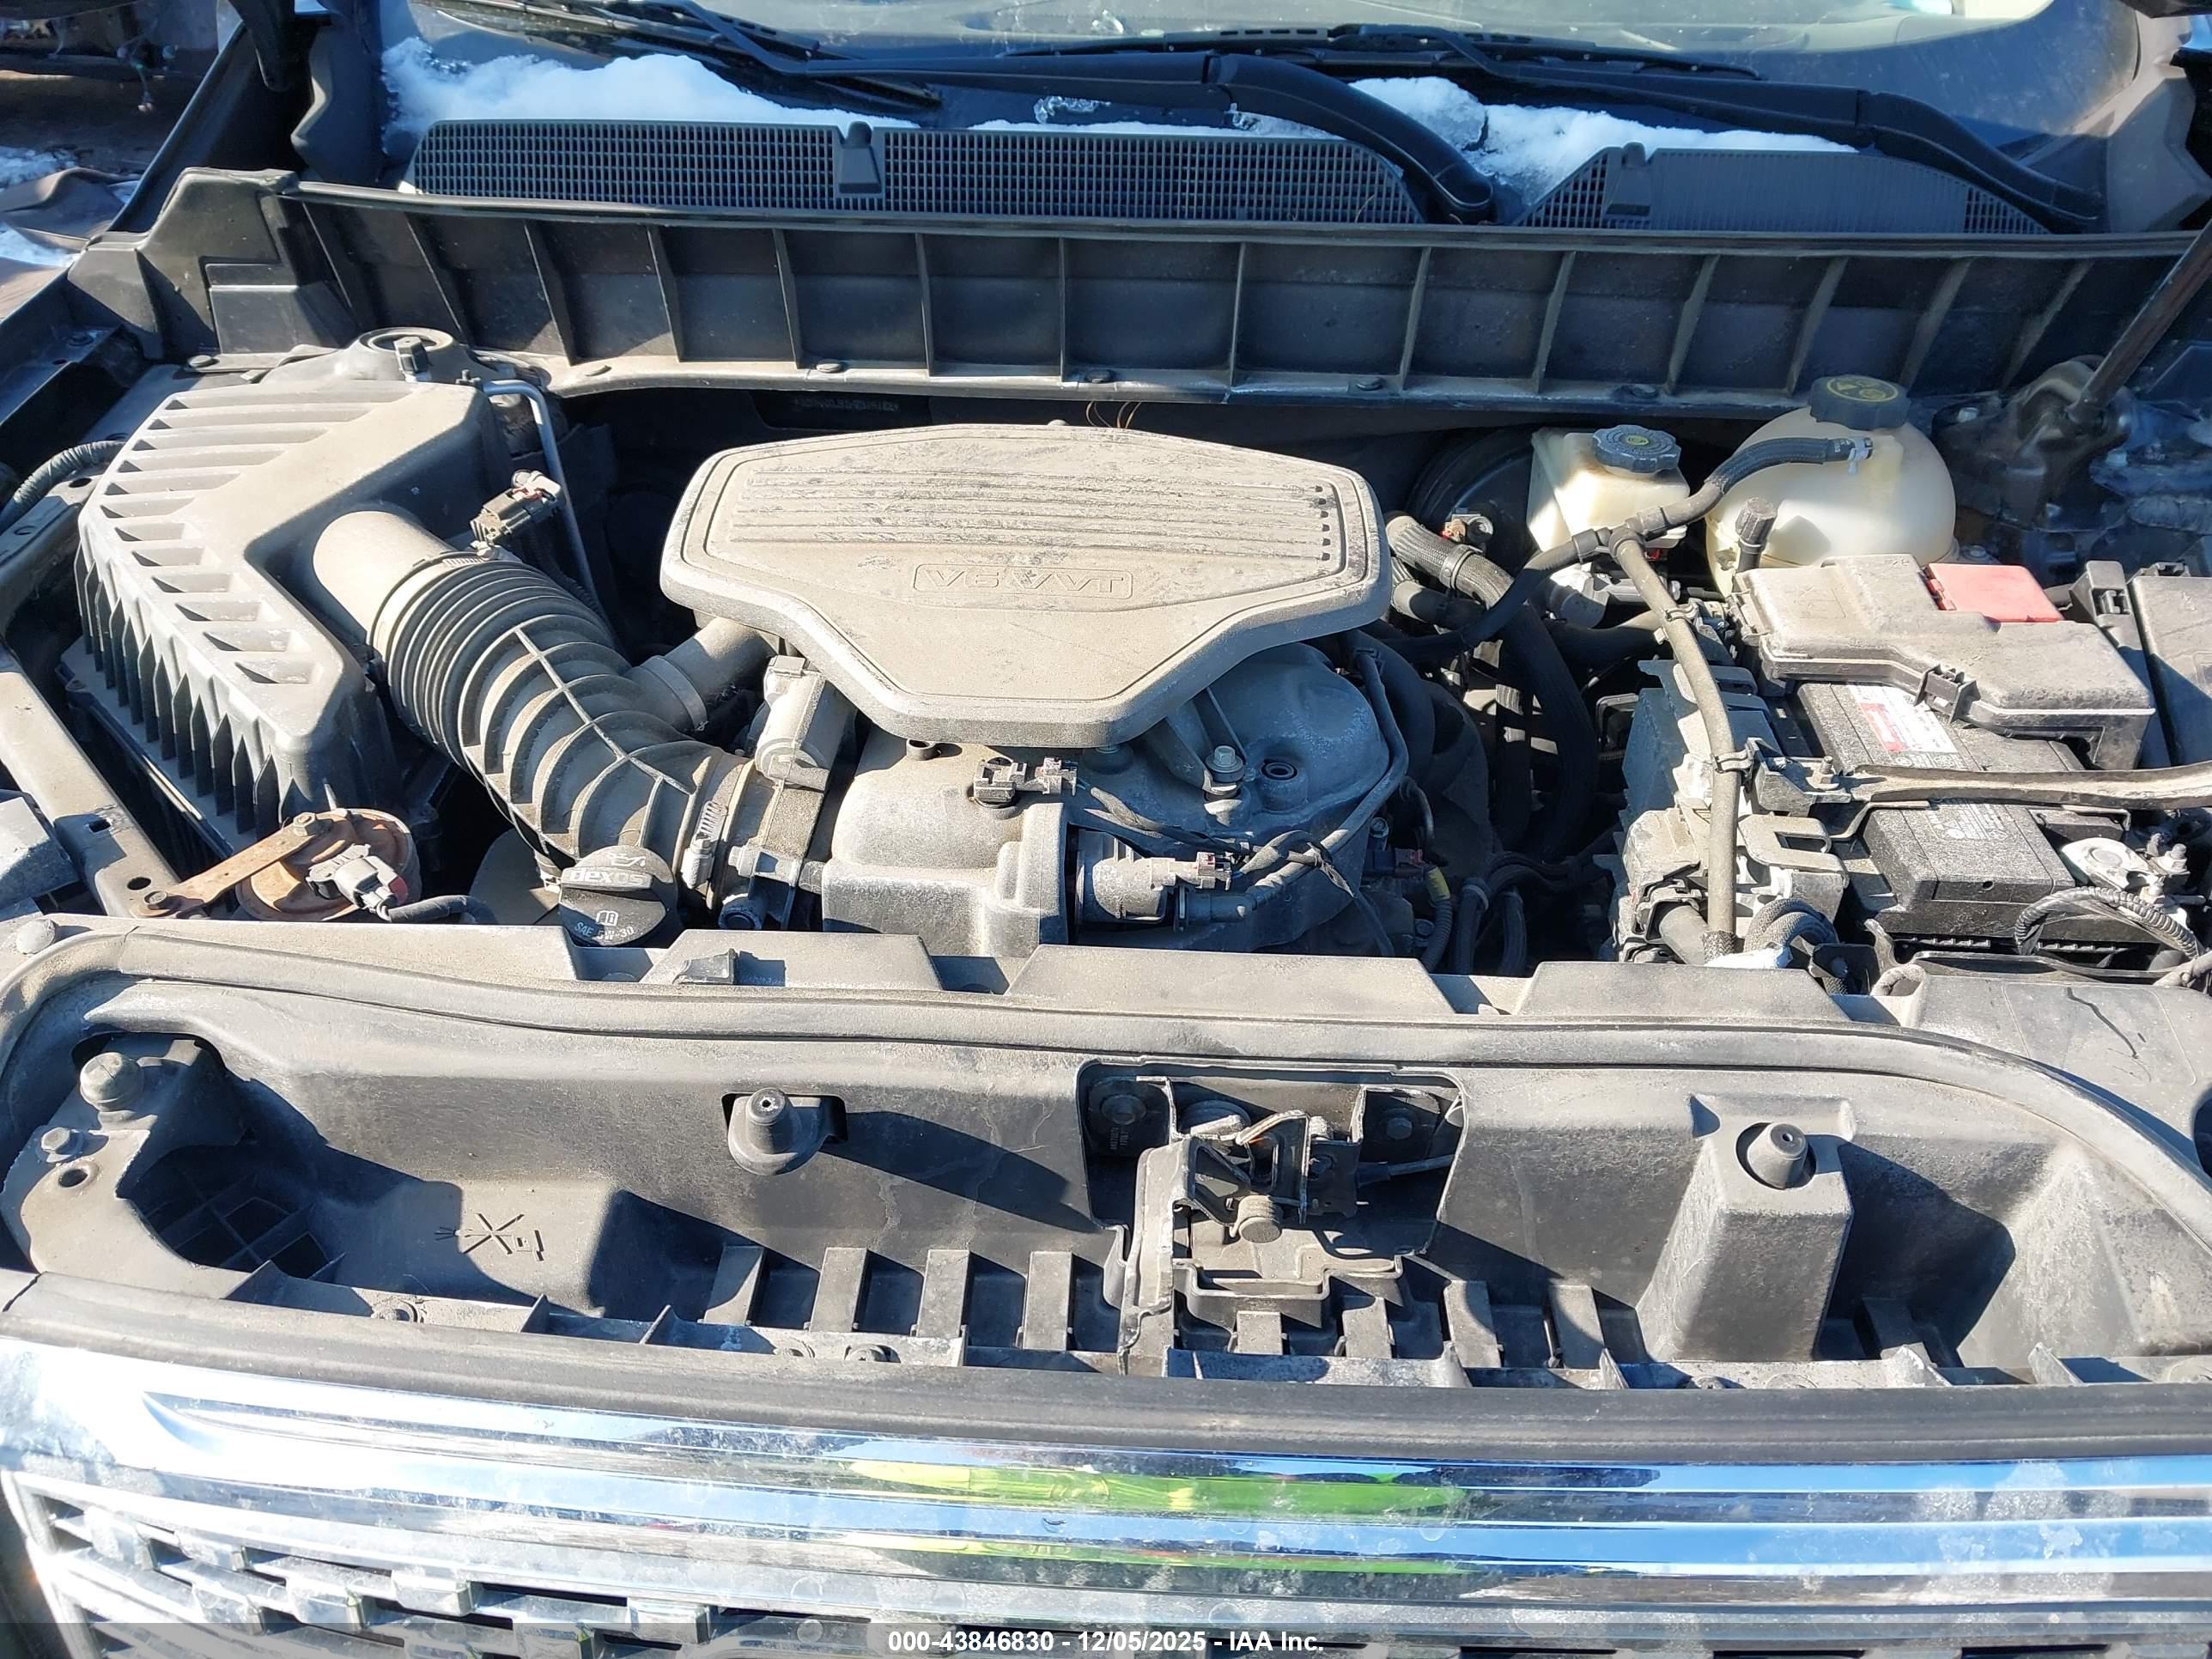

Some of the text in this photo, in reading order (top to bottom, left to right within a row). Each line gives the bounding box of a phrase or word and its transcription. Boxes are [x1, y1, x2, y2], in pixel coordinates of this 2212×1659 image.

[923, 568, 1124, 593] V6 VVT
[569, 867, 648, 886] dexos
[574, 921, 635, 940] SAE 5W-30
